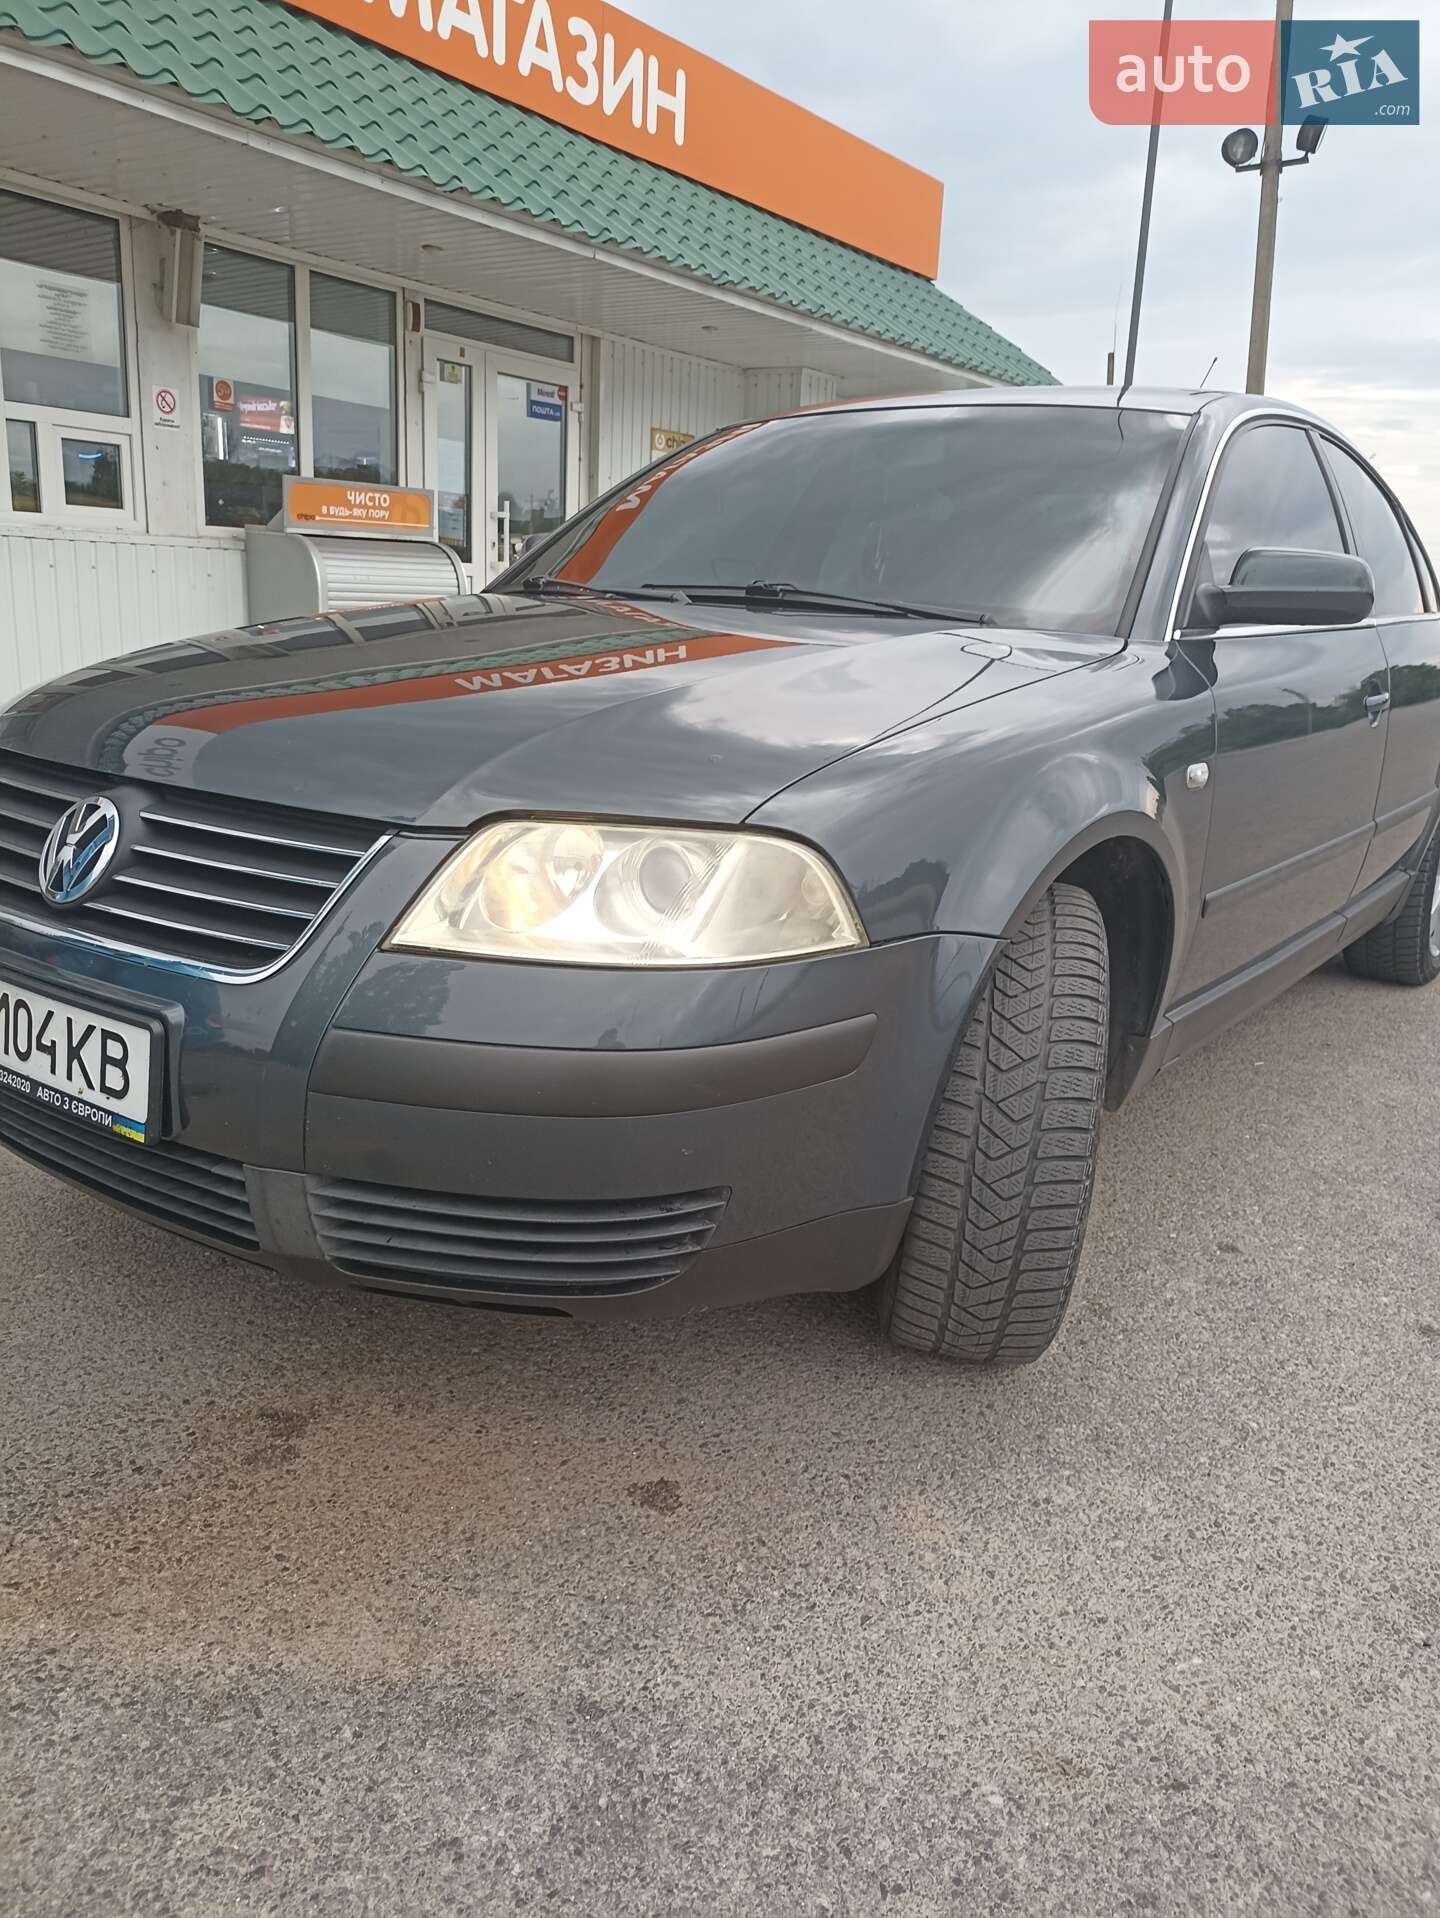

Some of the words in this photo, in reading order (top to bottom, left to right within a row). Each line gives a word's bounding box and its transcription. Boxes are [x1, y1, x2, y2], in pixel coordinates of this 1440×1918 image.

[347, 490, 390, 507] ЧИСТО
[321, 505, 328, 514] В
[329, 506, 367, 518] БУДЬ-ЯКУ
[368, 508, 390, 521] ПОРУ
[36, 1086, 62, 1106] АВТО
[71, 1100, 113, 1128] ЄВРОПИ
